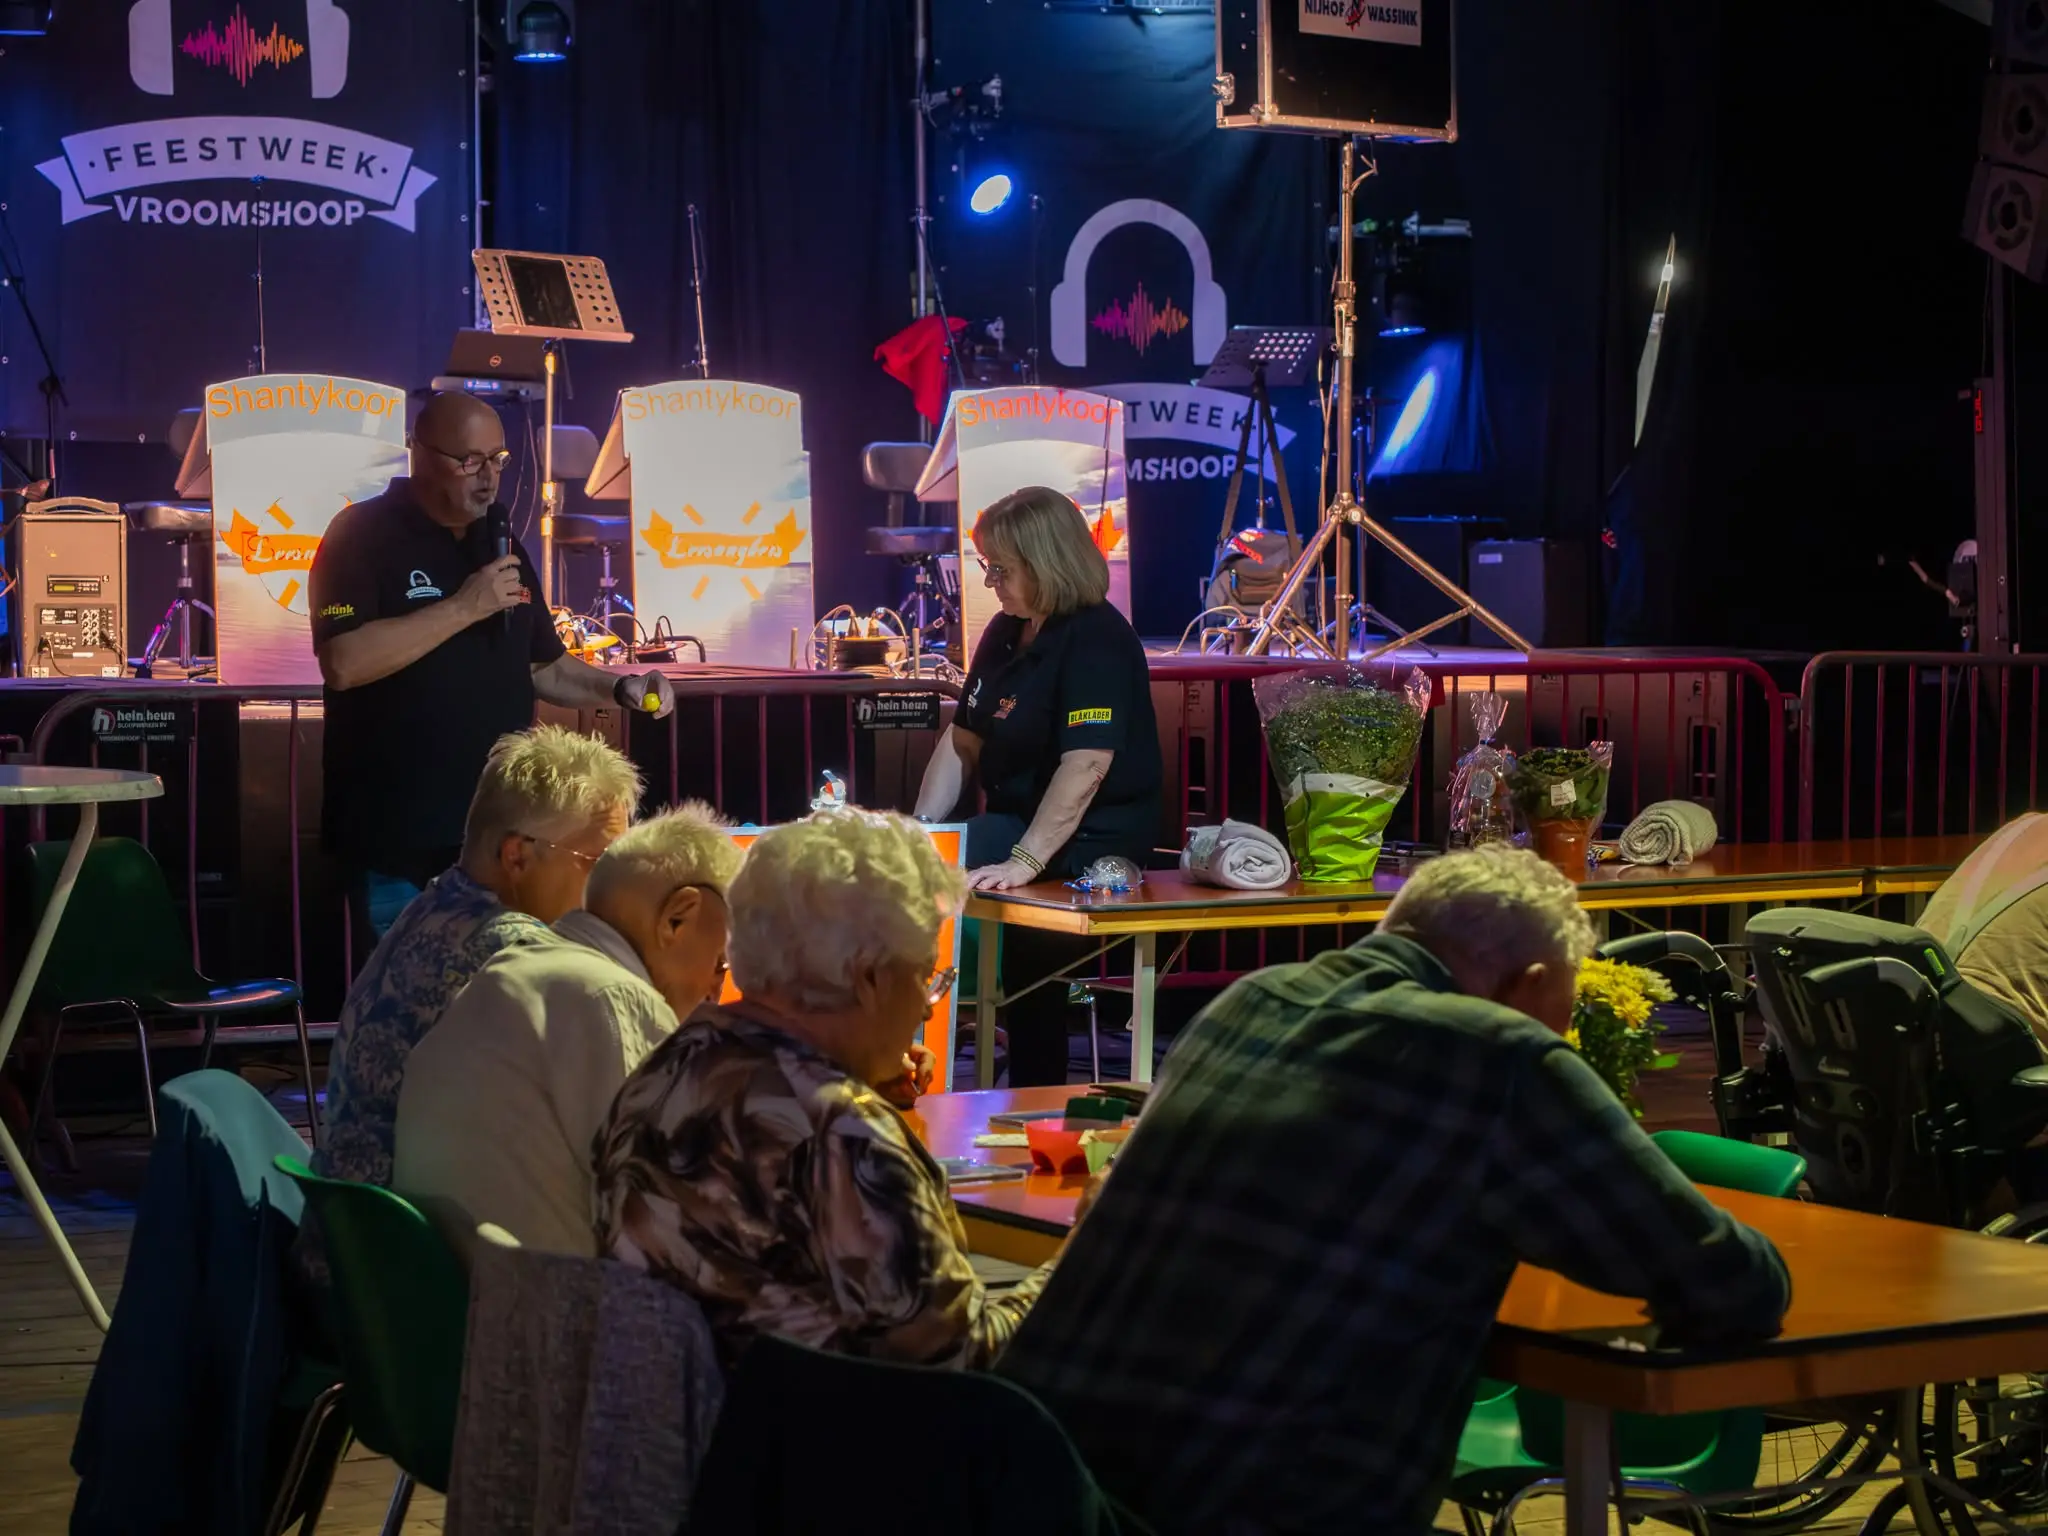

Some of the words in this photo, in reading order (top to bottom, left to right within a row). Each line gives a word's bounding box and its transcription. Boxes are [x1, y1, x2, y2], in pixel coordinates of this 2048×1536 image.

[1304, 0, 1345, 17] NIJHOF
[1367, 5, 1418, 26] WASSINK
[103, 136, 378, 179] FEESTWEEK
[113, 195, 366, 227] VROOMSHOOP
[208, 377, 401, 420] Shantykoor
[625, 383, 798, 422] Shantykoor
[957, 389, 1121, 427] Shantykoor
[1126, 400, 1249, 432] TWEEK
[1126, 454, 1237, 482] MSHOOP
[117, 710, 143, 721] hein
[147, 709, 175, 721] heun
